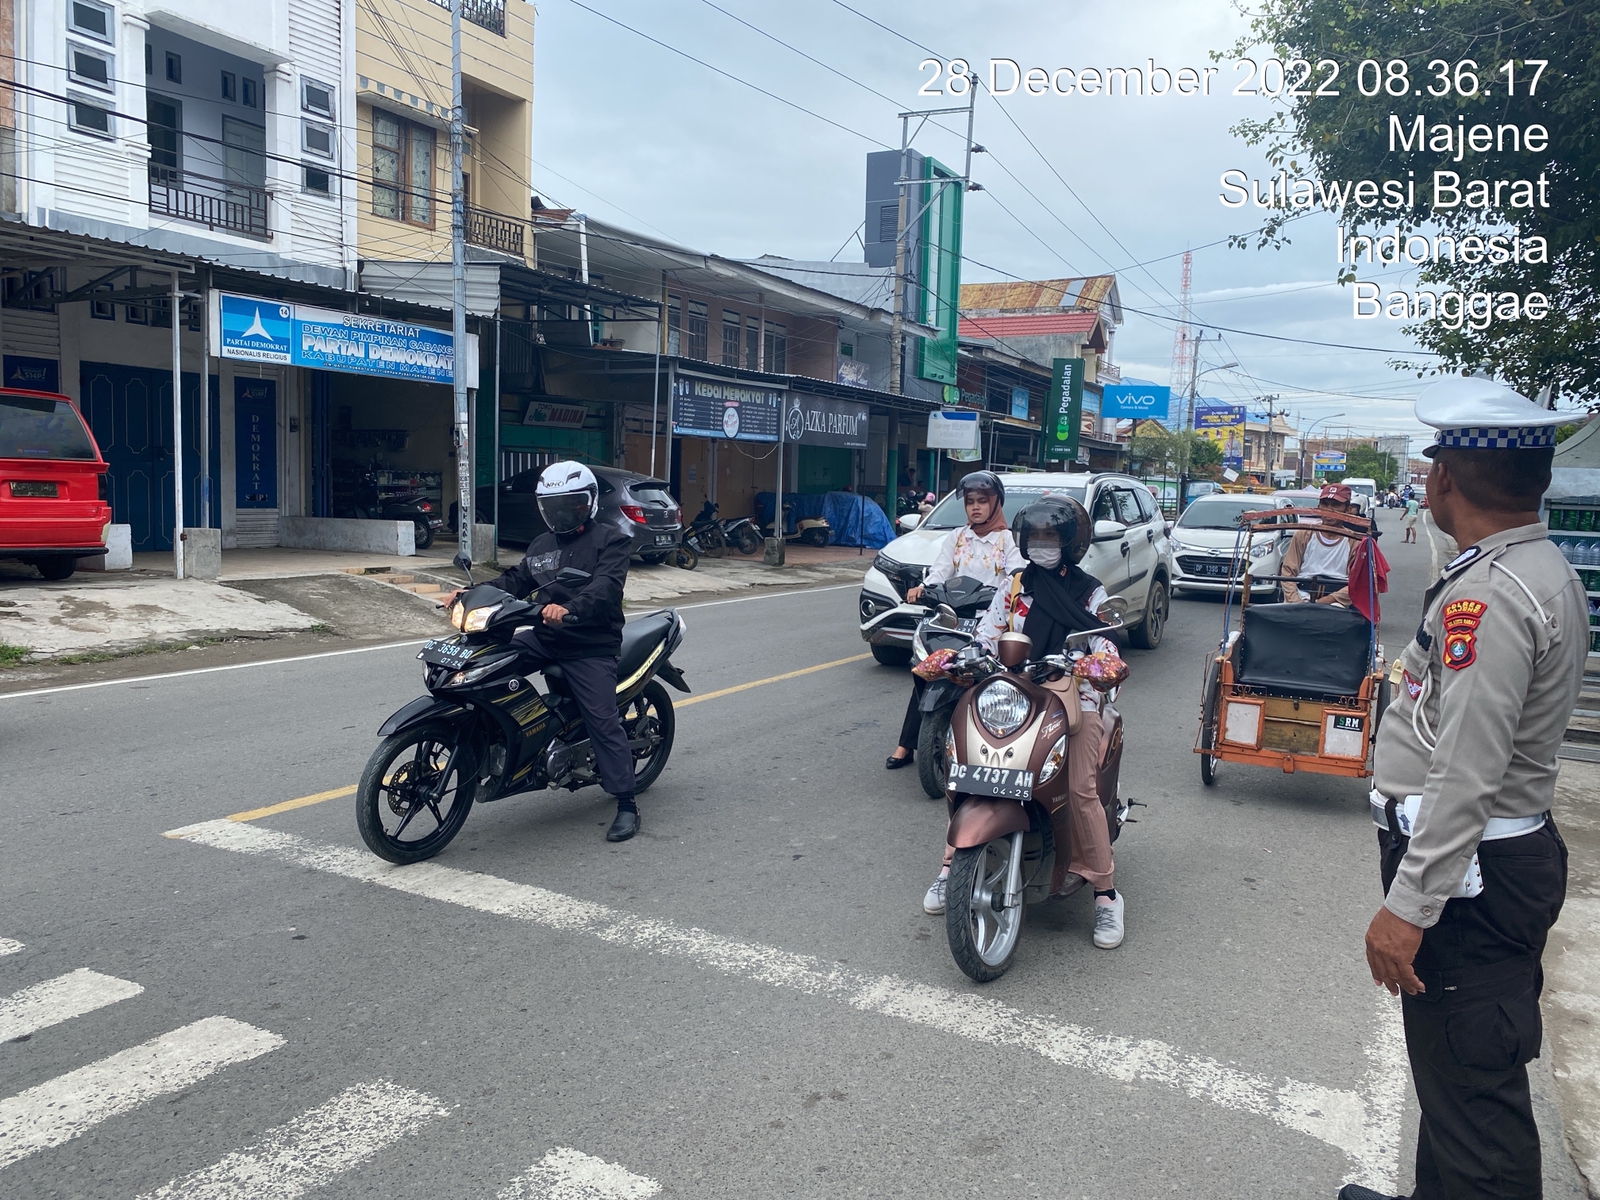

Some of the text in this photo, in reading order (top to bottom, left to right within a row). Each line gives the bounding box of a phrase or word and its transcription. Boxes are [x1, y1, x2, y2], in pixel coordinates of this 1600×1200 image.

[280, 308, 288, 316] 14
[342, 315, 421, 339] SEKRETARIAT
[226, 338, 288, 352] PARTAI DEMOKRAT
[302, 323, 454, 357] DEWAN PIMPINAN CABANG
[226, 348, 288, 361] NASIONALIS RELIGIUS
[302, 335, 454, 371] PARTAI DEMOKRAT
[302, 351, 454, 378] KABUPATEN MAJENE
[1058, 364, 1072, 414] Pegadaian
[1116, 392, 1155, 405] vivo
[537, 403, 553, 411] TOKO
[548, 407, 584, 424] MADINA
[804, 409, 827, 433] AZKA
[827, 413, 858, 436] PARFUM
[250, 414, 261, 491] DEMOKRAT
[437, 643, 461, 656] 3658
[1339, 716, 1360, 728] SRM
[949, 763, 1034, 788] DC 4737 AH
